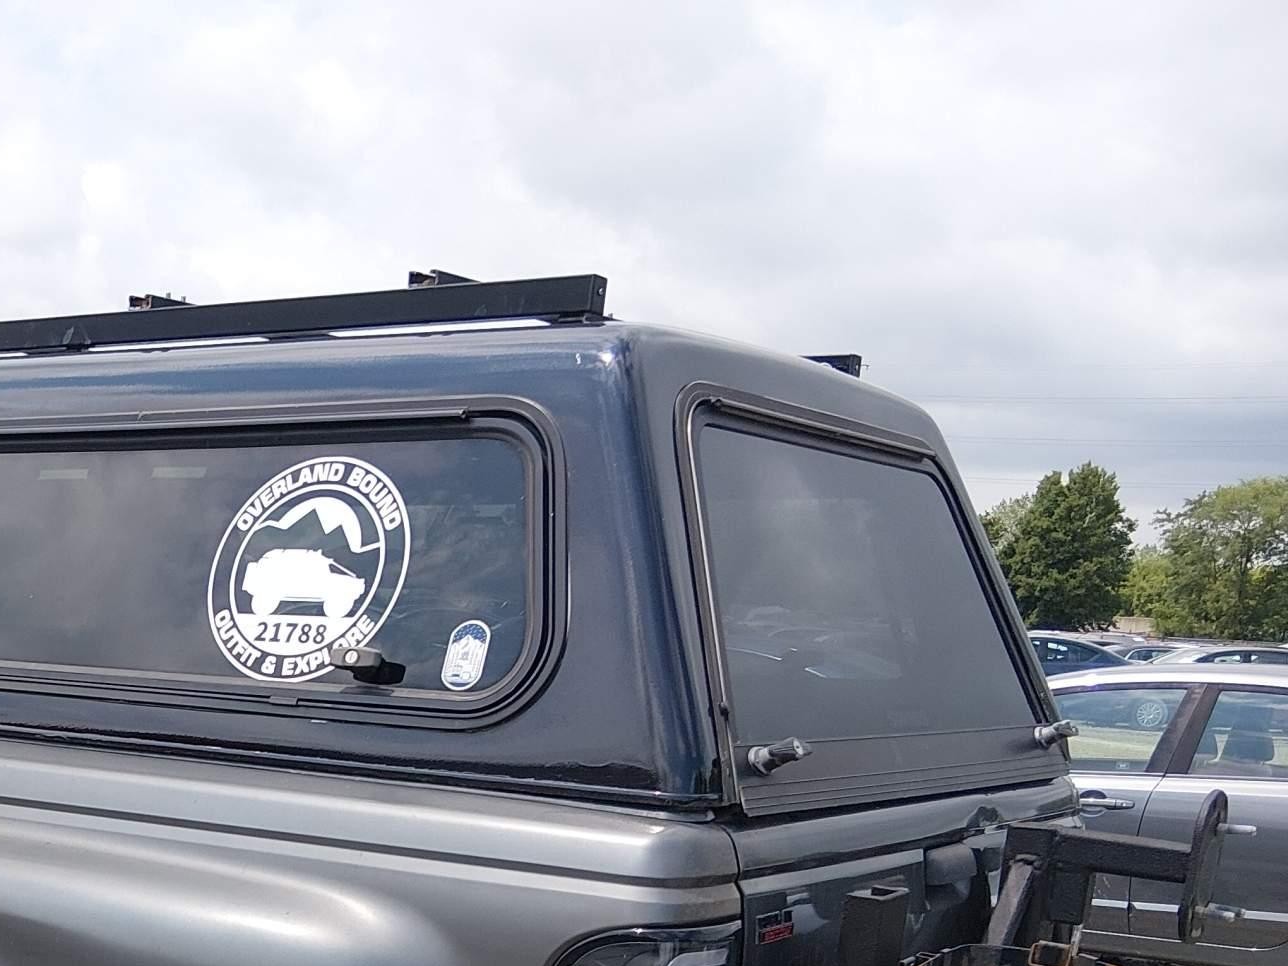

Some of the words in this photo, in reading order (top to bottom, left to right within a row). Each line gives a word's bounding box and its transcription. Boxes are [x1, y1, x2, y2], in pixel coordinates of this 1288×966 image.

[237, 463, 345, 531] OVERLAND
[346, 467, 402, 531] BOUND
[214, 609, 262, 667] OUTFIT
[261, 655, 277, 675] &
[254, 622, 327, 644] 21788
